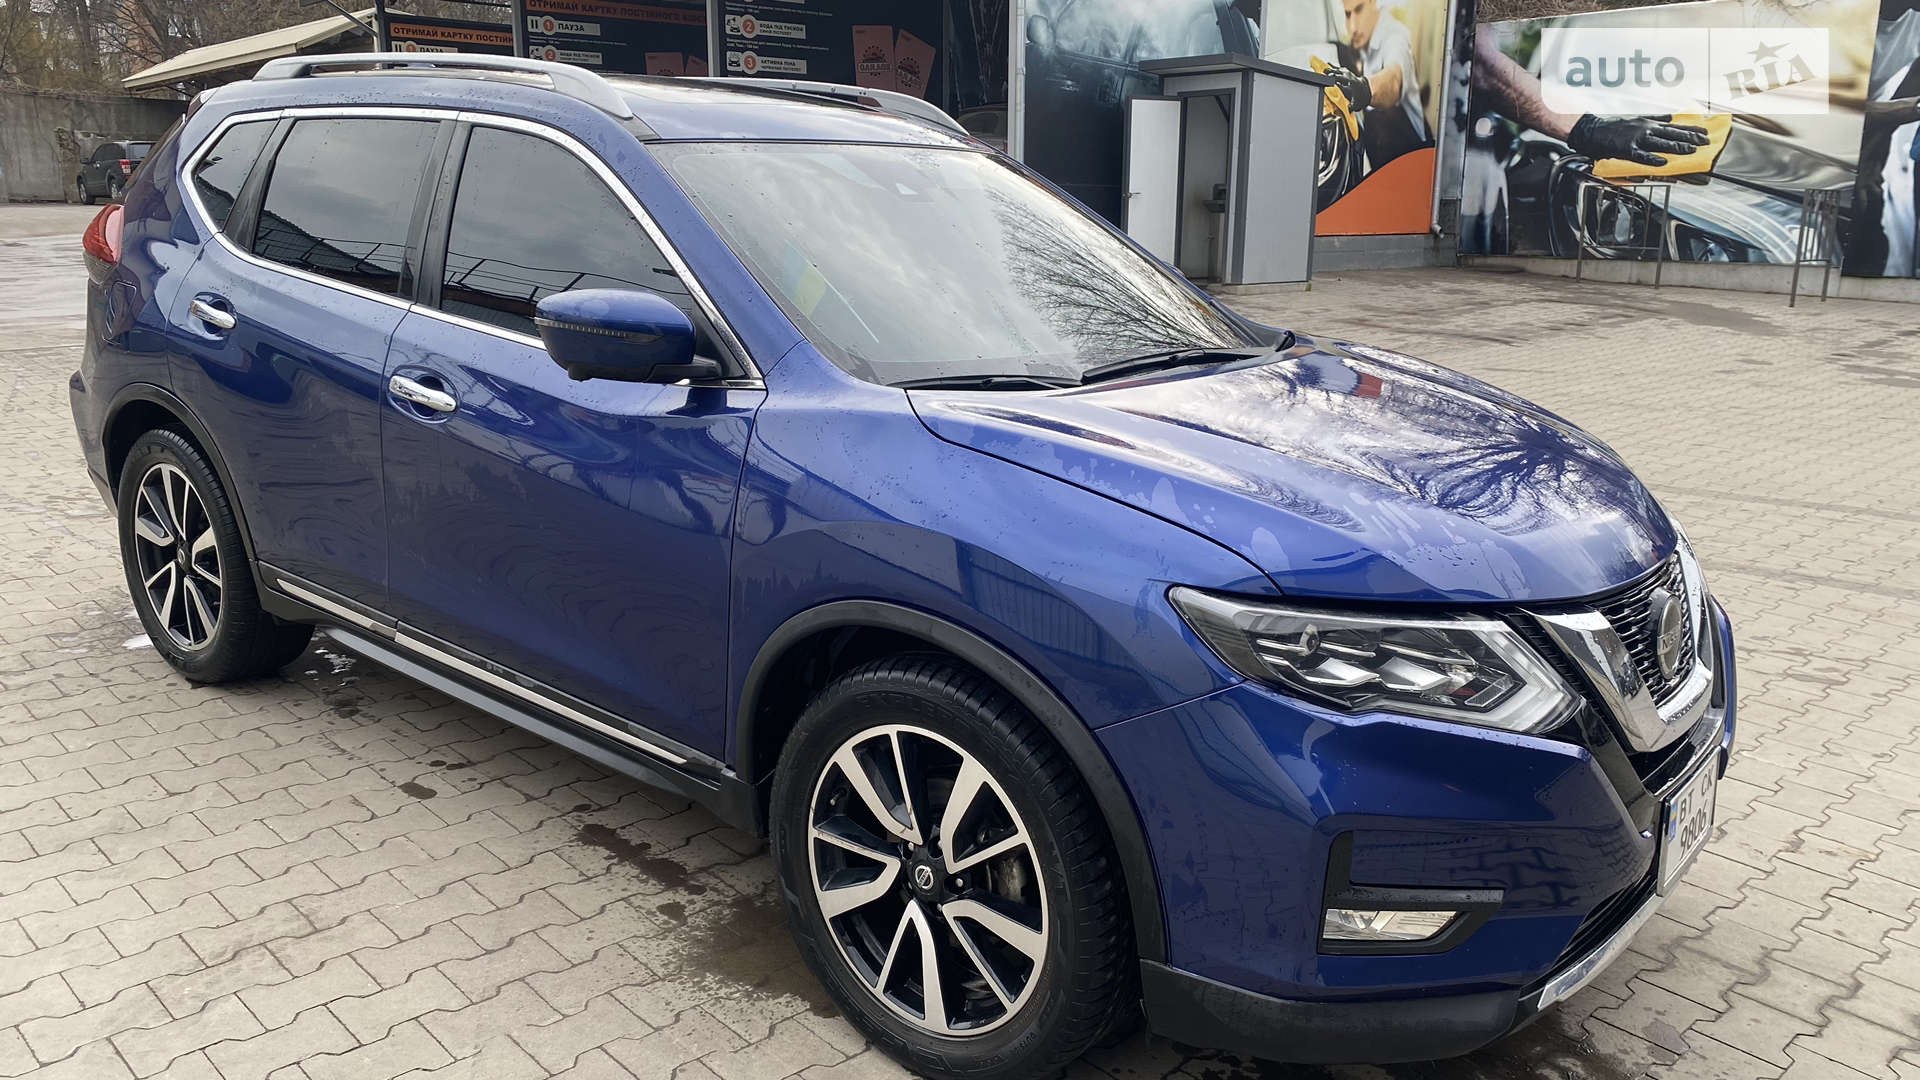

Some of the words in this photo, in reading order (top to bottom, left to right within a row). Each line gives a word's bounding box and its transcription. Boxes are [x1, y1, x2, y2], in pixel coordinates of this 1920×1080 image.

[529, 0, 578, 11] ОТРИМАЙ
[581, 3, 618, 15] КАРТКУ
[620, 7, 680, 20] ПОСТІЙНОГО
[393, 26, 438, 38] ОТРИМАЙ
[440, 31, 474, 41] КАРТКУ
[558, 23, 585, 32] ПАУЗА
[859, 63, 891, 72] GARAGE
[1679, 788, 1695, 825] BT
[1701, 764, 1715, 797] CK
[1679, 799, 1709, 861] 9806
[1009, 1031, 1037, 1058] OUTSIDE
